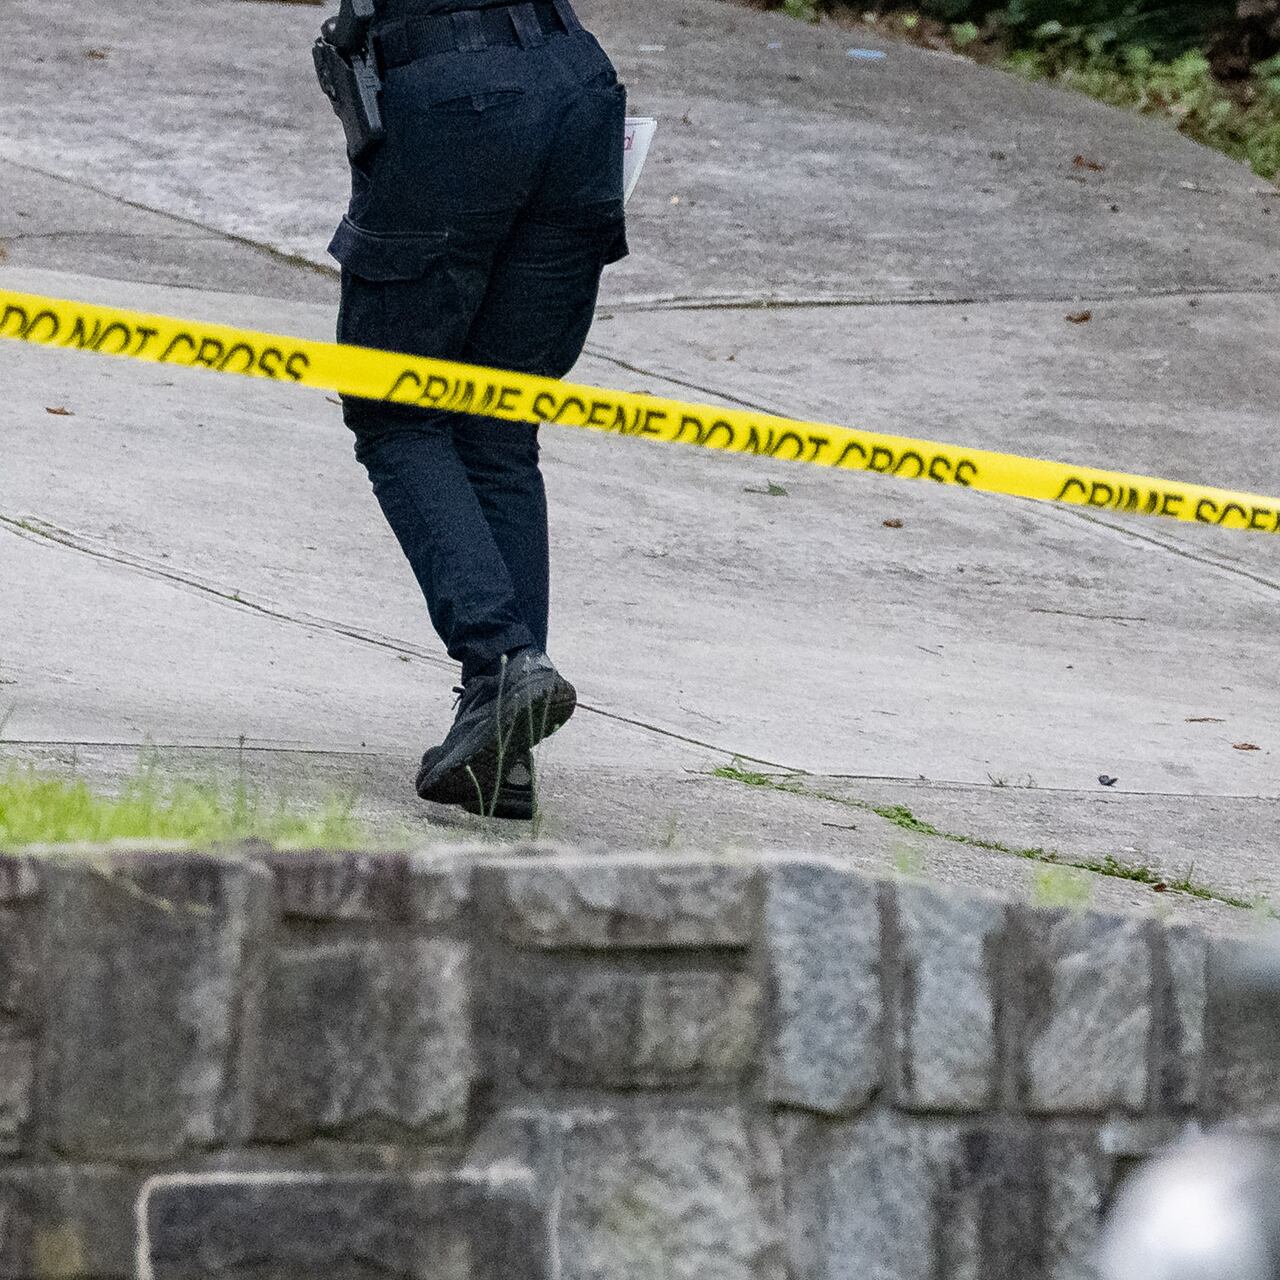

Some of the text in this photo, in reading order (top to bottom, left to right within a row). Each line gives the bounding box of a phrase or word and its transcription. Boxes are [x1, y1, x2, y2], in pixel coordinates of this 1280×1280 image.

[64, 316, 159, 355] NOT
[158, 332, 310, 381] CROSS
[385, 369, 978, 487] CRIME SCENE DO NOT CROSS
